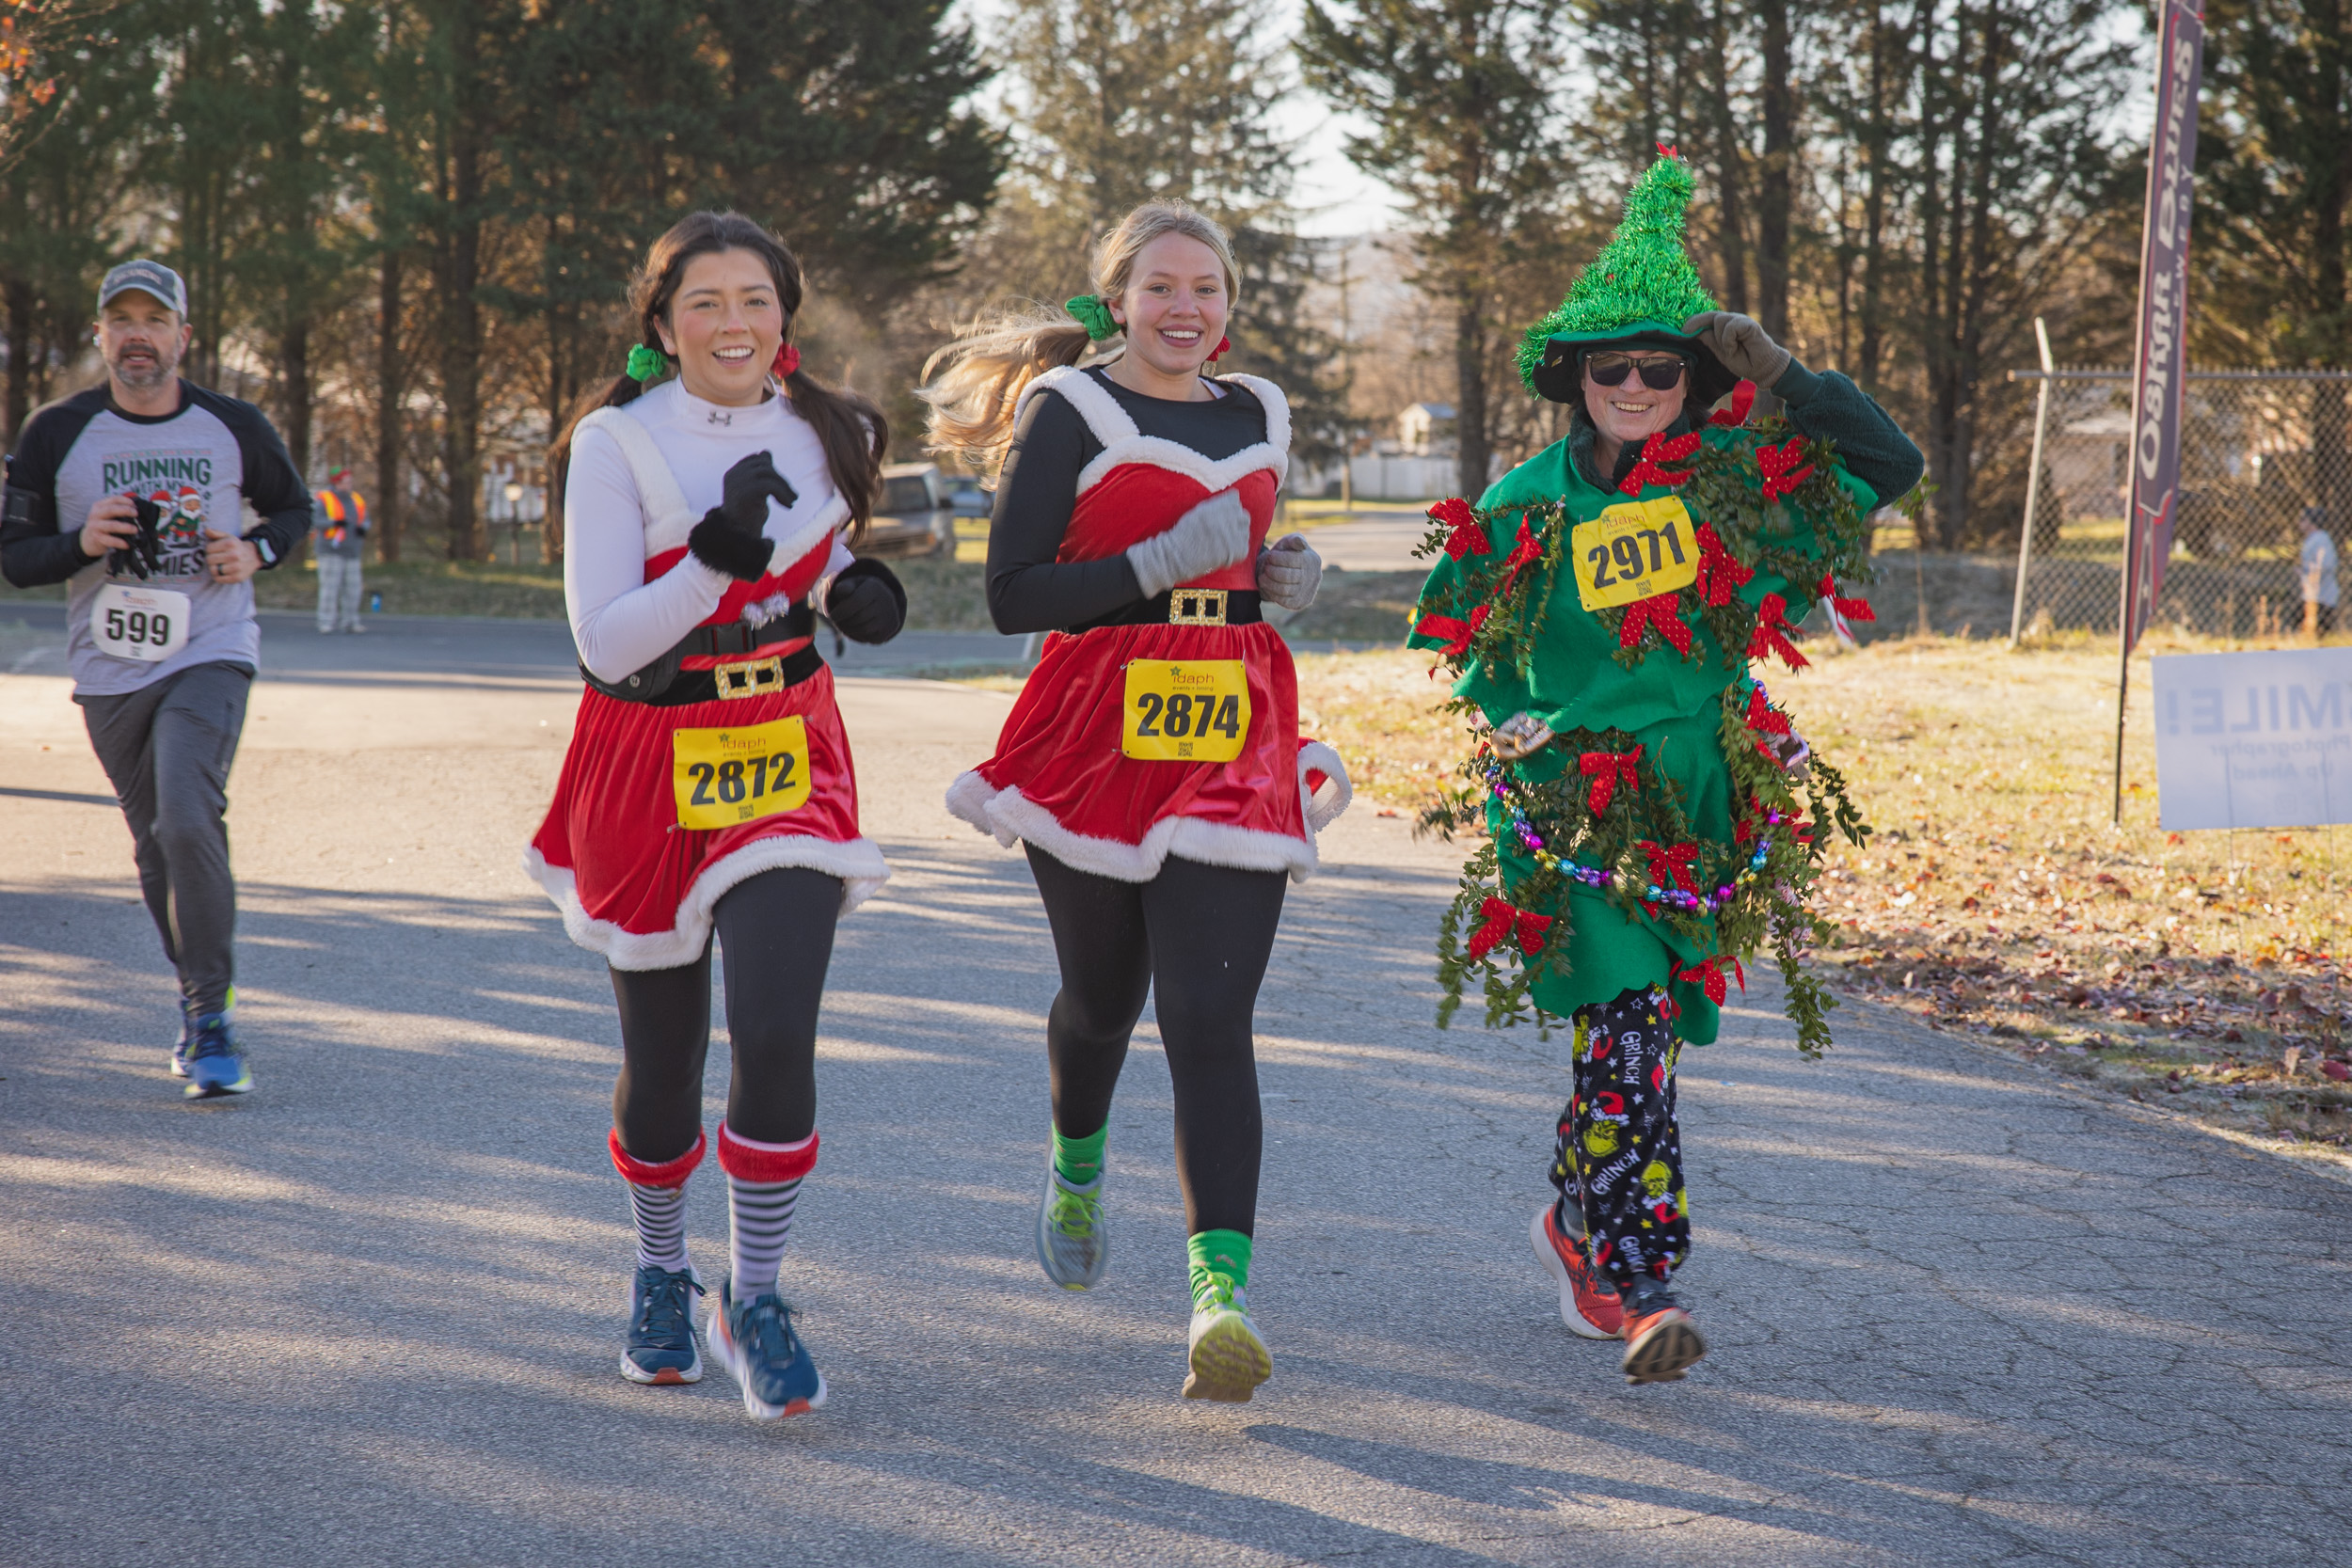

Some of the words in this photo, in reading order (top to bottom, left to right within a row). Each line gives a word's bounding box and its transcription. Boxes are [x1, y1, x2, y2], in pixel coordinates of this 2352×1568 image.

[103, 458, 212, 494] RUNNING
[1588, 521, 1686, 590] 2971
[105, 608, 170, 647] 599
[1172, 673, 1215, 685] idaph
[1137, 692, 1240, 738] 2874
[688, 752, 796, 806] 2872
[1619, 1030, 1645, 1085] GRINCH
[1590, 1147, 1642, 1196] GRINCH
